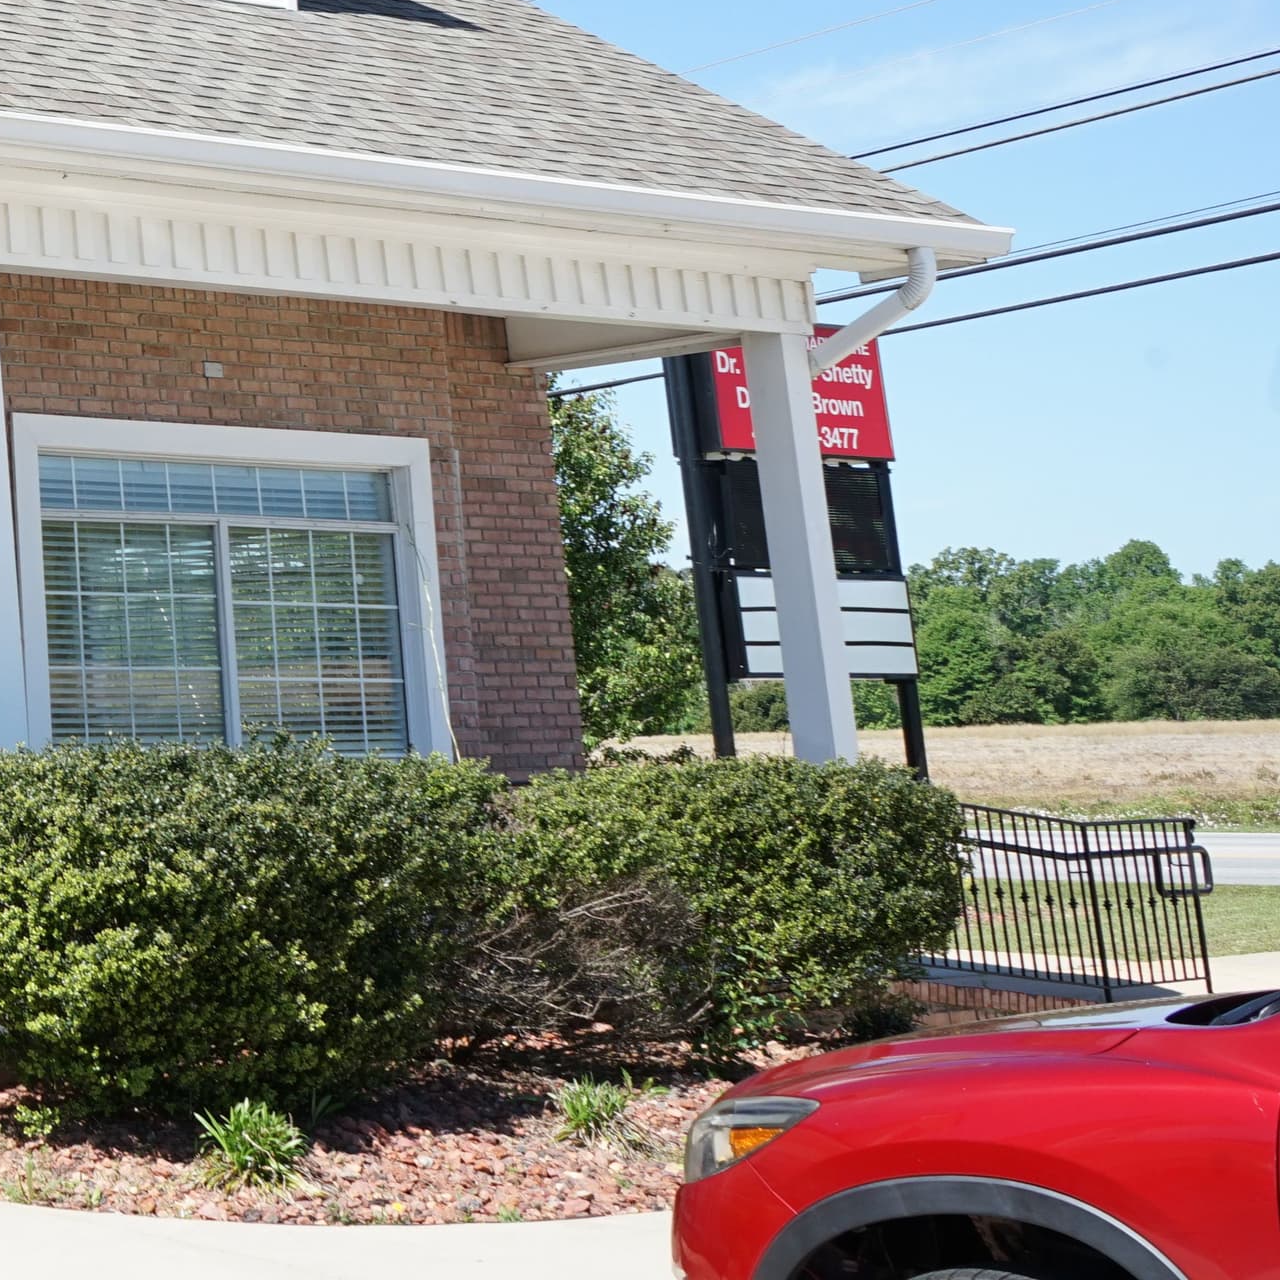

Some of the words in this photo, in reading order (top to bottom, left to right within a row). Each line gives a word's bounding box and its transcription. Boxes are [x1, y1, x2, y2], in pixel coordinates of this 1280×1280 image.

[715, 350, 741, 374] Dr.
[820, 364, 873, 390] Shetty
[736, 387, 751, 408] D
[812, 392, 864, 417] Brown
[816, 427, 859, 449] -3477
